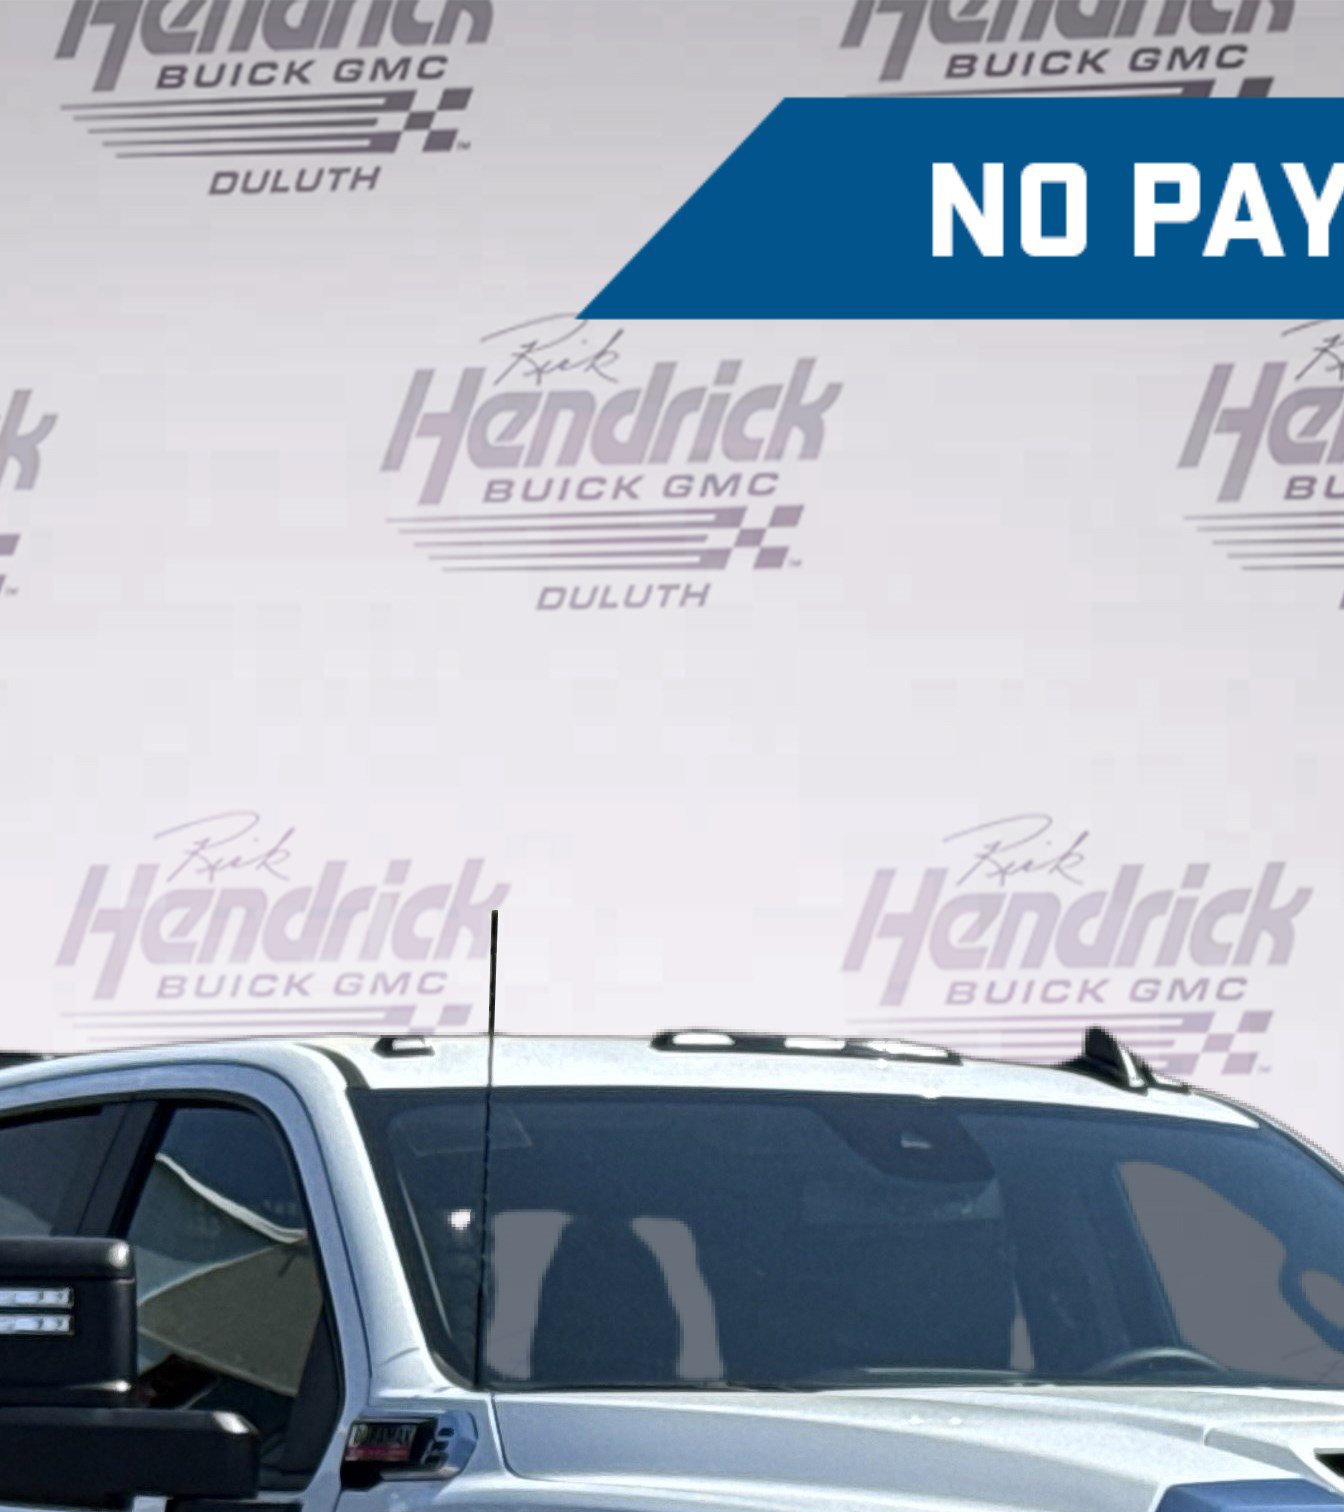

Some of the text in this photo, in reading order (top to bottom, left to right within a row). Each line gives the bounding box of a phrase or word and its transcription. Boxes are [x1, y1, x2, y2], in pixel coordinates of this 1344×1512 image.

[156, 55, 449, 90] BUICK GMC
[945, 44, 1248, 80] BUICK GMC
[208, 166, 381, 195] DULUTH
[380, 357, 844, 505] Hendrick
[482, 472, 780, 503] BUICK GMC
[536, 583, 711, 611] DULUTH
[55, 857, 512, 1001] Hendrick
[841, 861, 1314, 1007] Hendrick
[155, 971, 448, 1000] BUICK GMC
[945, 976, 1249, 1006] BUICK GMC
